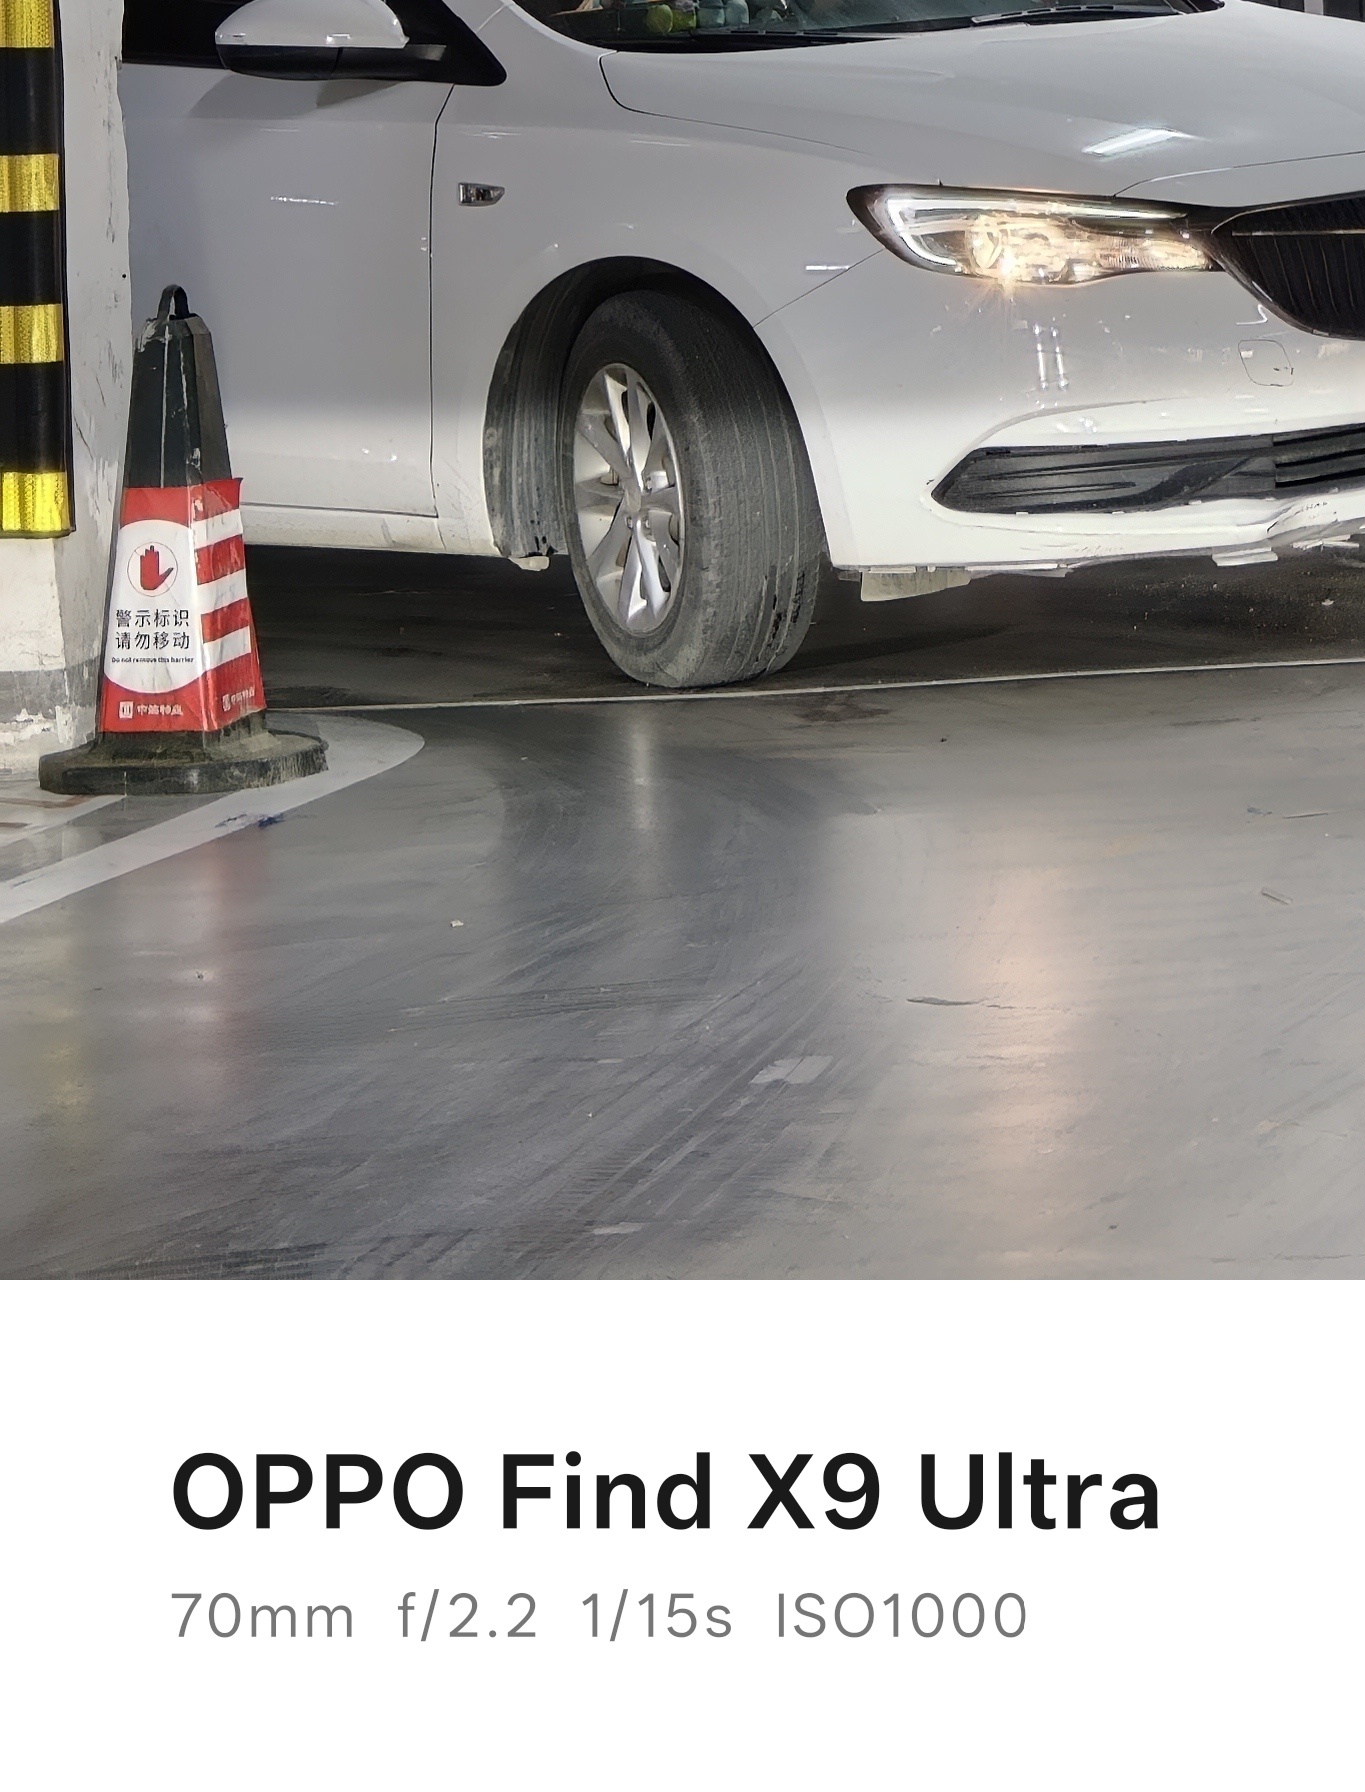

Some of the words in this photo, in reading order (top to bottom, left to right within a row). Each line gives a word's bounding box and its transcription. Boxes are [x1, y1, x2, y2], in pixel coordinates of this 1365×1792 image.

[116, 609, 189, 628] 警示标识
[116, 632, 190, 650] 请勿移动
